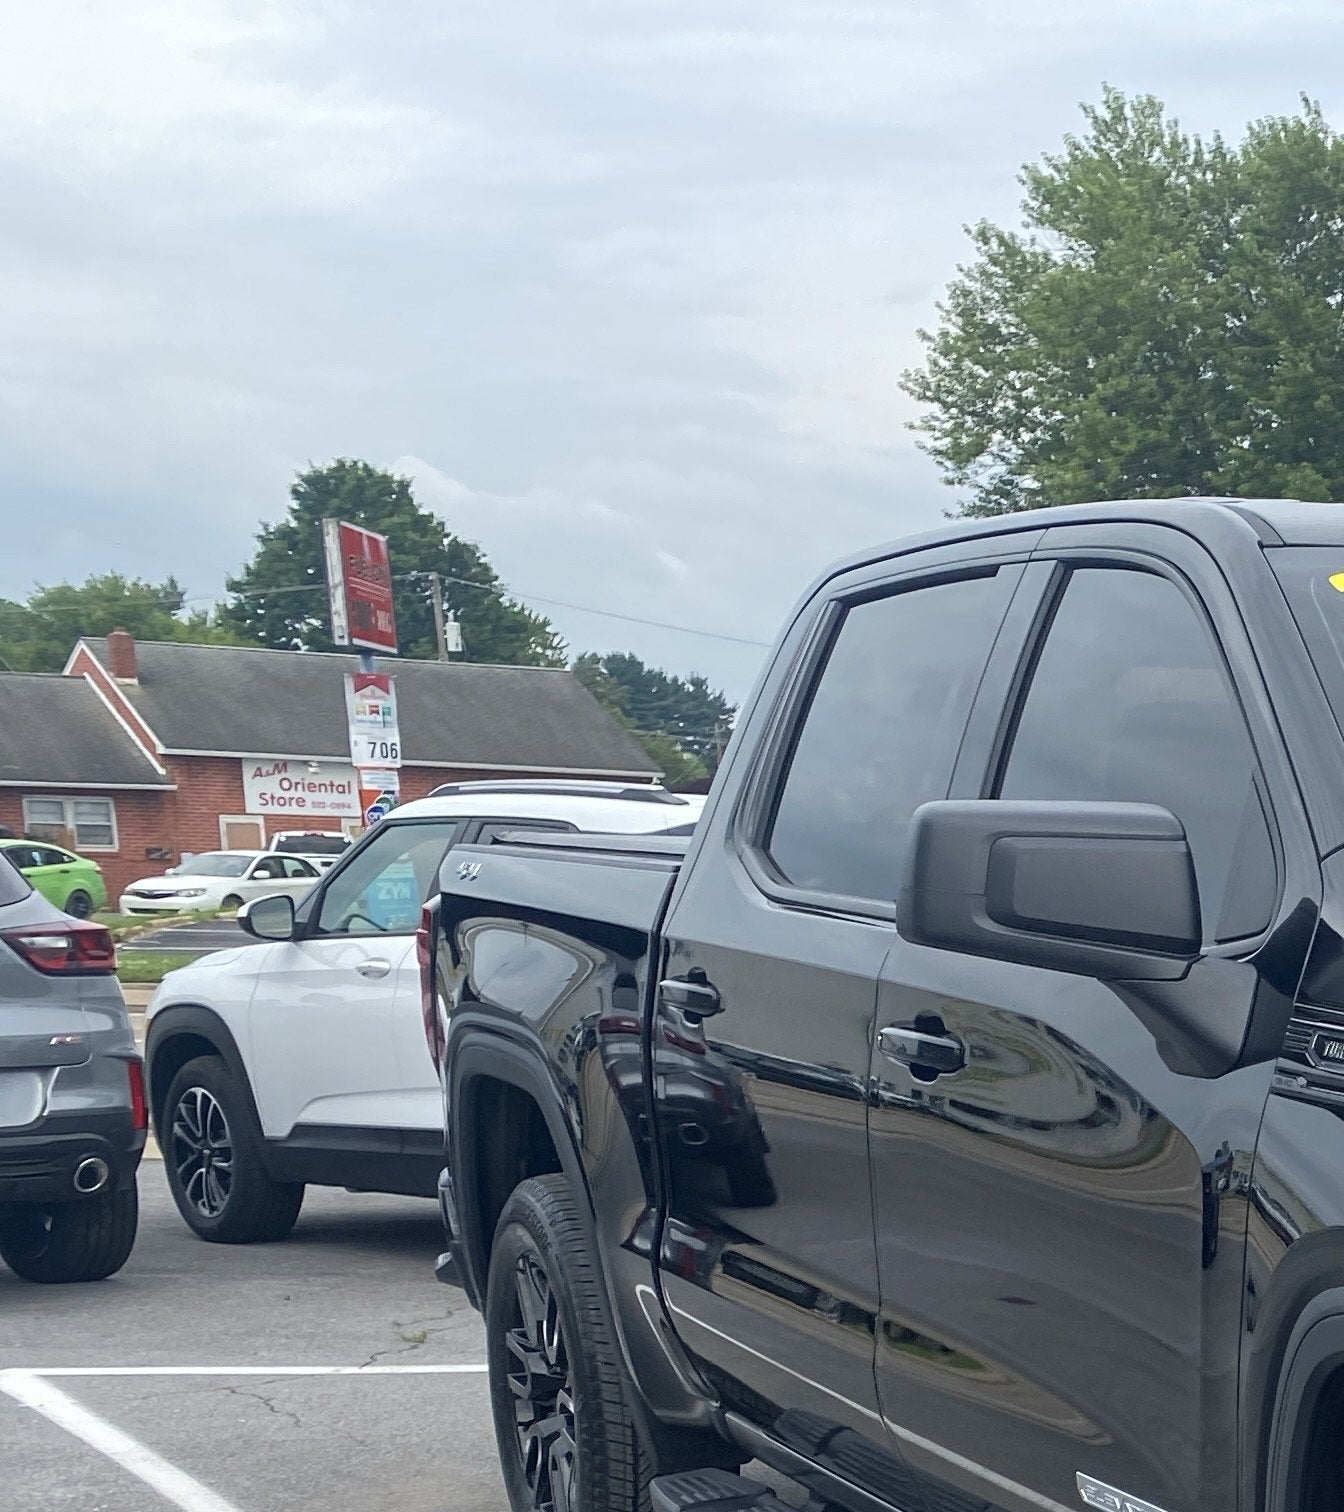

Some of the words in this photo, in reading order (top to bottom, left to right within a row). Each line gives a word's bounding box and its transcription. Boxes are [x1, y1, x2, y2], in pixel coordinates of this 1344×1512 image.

[252, 761, 288, 780] A&M
[279, 777, 352, 794] Oriental
[259, 792, 306, 808] Store
